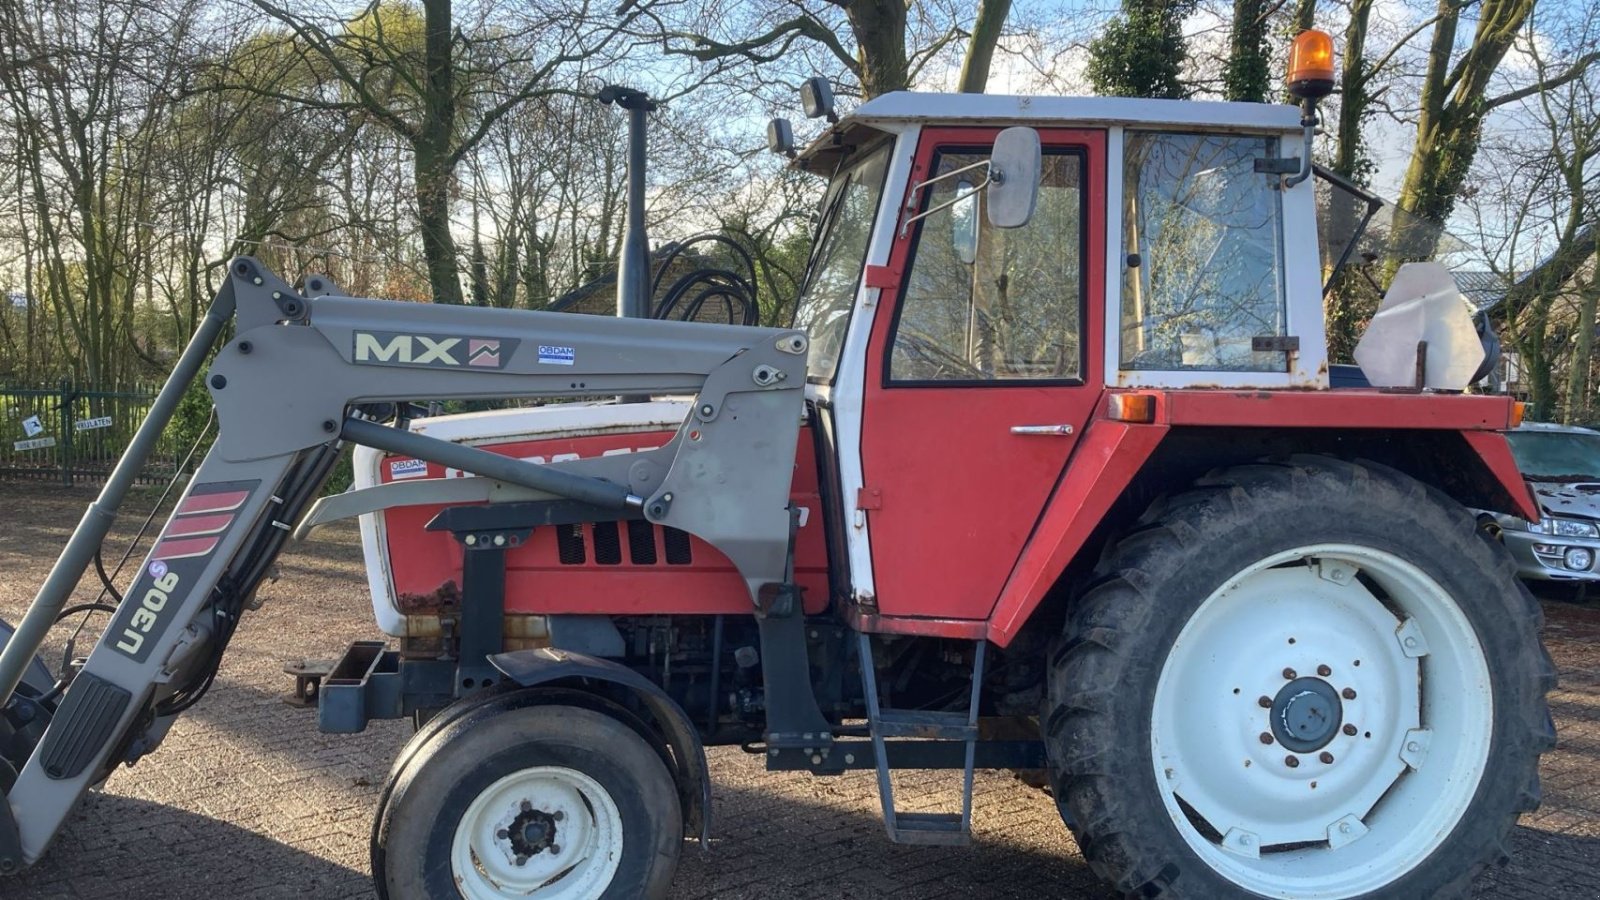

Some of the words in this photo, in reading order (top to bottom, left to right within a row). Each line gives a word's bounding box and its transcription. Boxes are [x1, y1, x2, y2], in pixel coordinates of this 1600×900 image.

[355, 333, 463, 366] MX
[539, 346, 574, 355] OBDAM
[391, 459, 427, 471] OBDAM
[116, 572, 180, 655] U306
